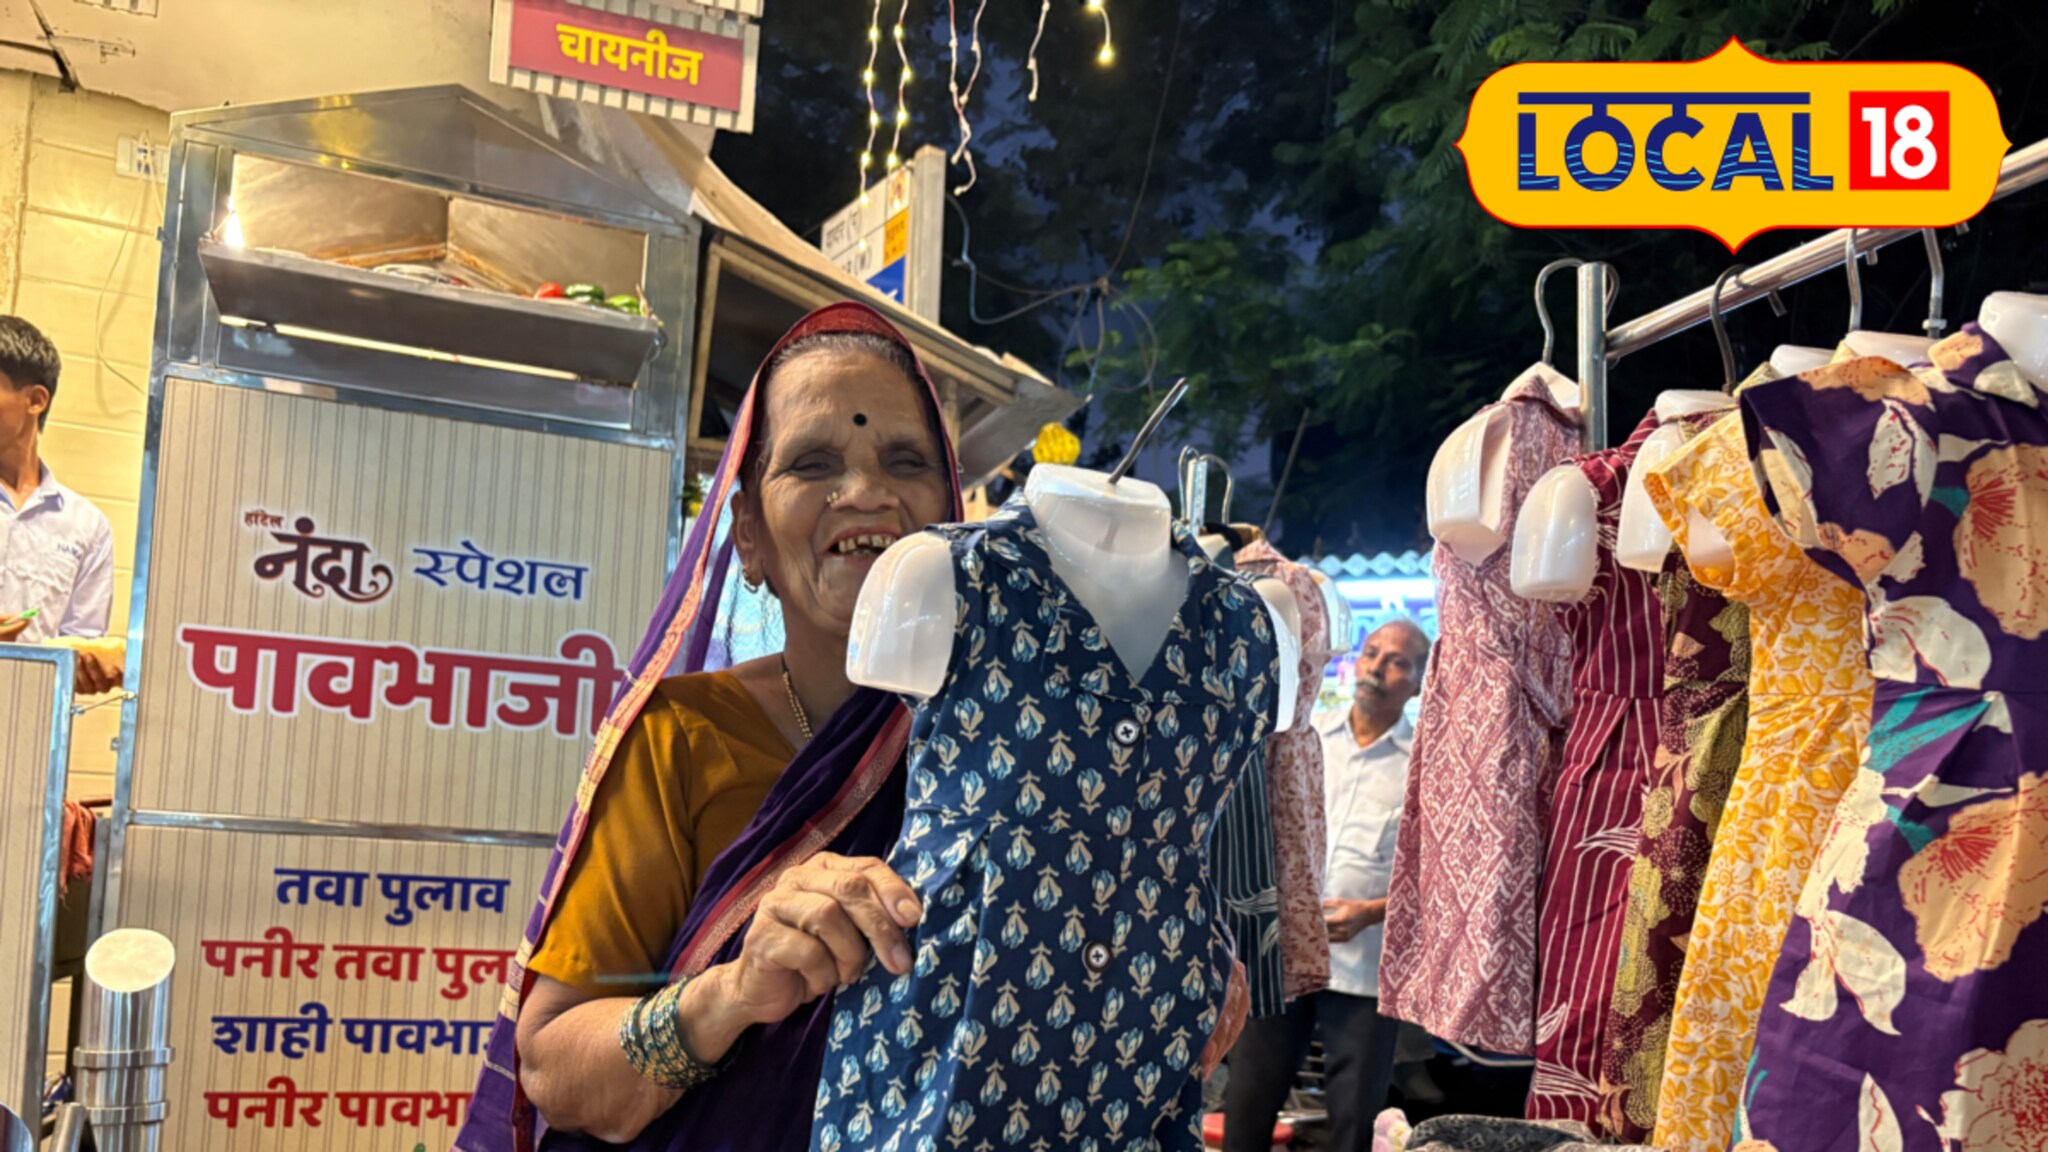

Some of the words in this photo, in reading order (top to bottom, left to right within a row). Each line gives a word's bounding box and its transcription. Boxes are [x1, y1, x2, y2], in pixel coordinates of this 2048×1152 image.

[556, 24, 703, 85] चायनीज
[254, 517, 393, 604] नंदा
[412, 540, 589, 599] स्पेशल
[181, 628, 625, 736] पावभाजी
[274, 867, 368, 906] तवा
[377, 873, 510, 925] पुलाव
[201, 927, 324, 979] पनीर
[333, 944, 424, 981] तवा
[433, 947, 517, 1000] पुल
[211, 1002, 333, 1059] शाही
[341, 1018, 496, 1055] पावभा
[204, 1076, 328, 1129] पनीर
